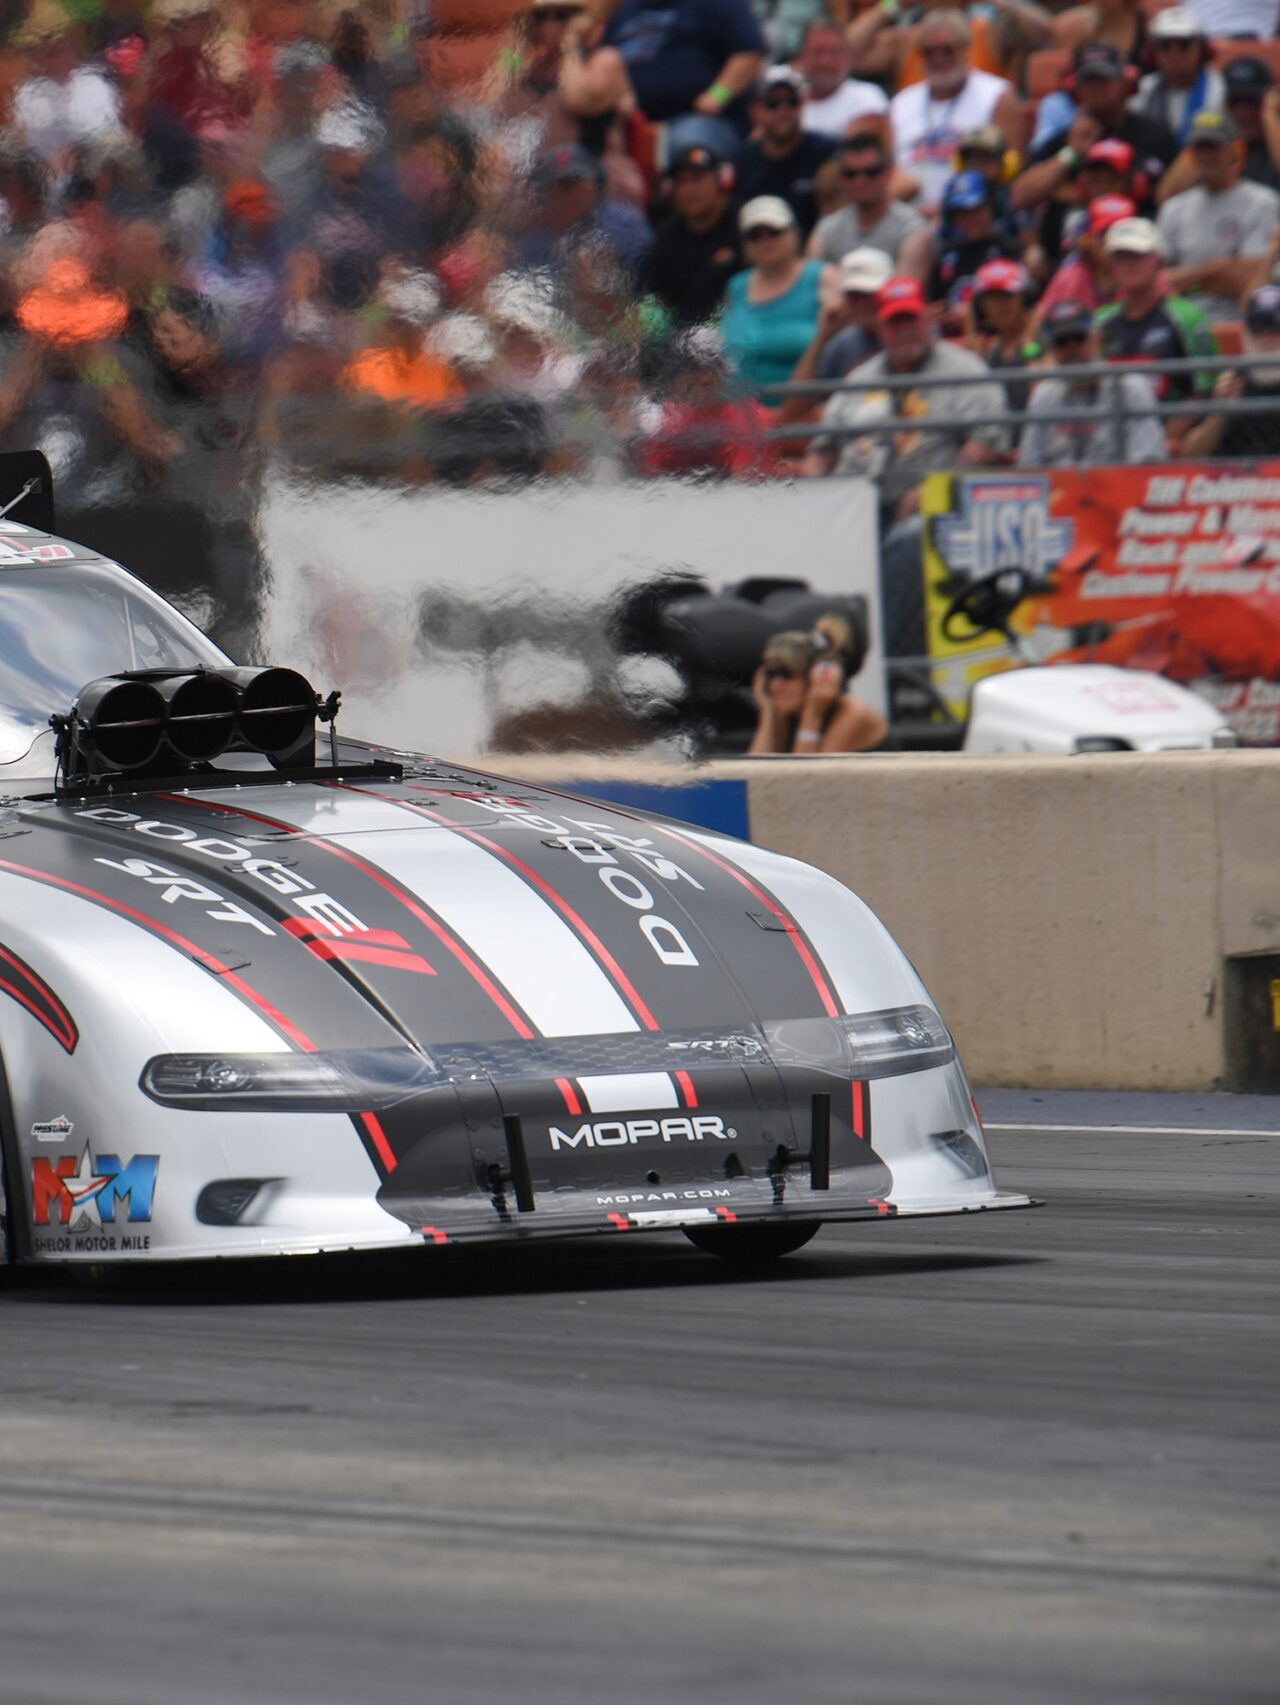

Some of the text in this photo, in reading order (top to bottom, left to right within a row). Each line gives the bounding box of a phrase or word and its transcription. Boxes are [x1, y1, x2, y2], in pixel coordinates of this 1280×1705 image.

[74, 807, 370, 937] DODGE
[93, 857, 278, 937] SRT
[596, 1188, 731, 1205] MOPAR.COM
[34, 1235, 151, 1253] SHELOR MOTOR MILE
